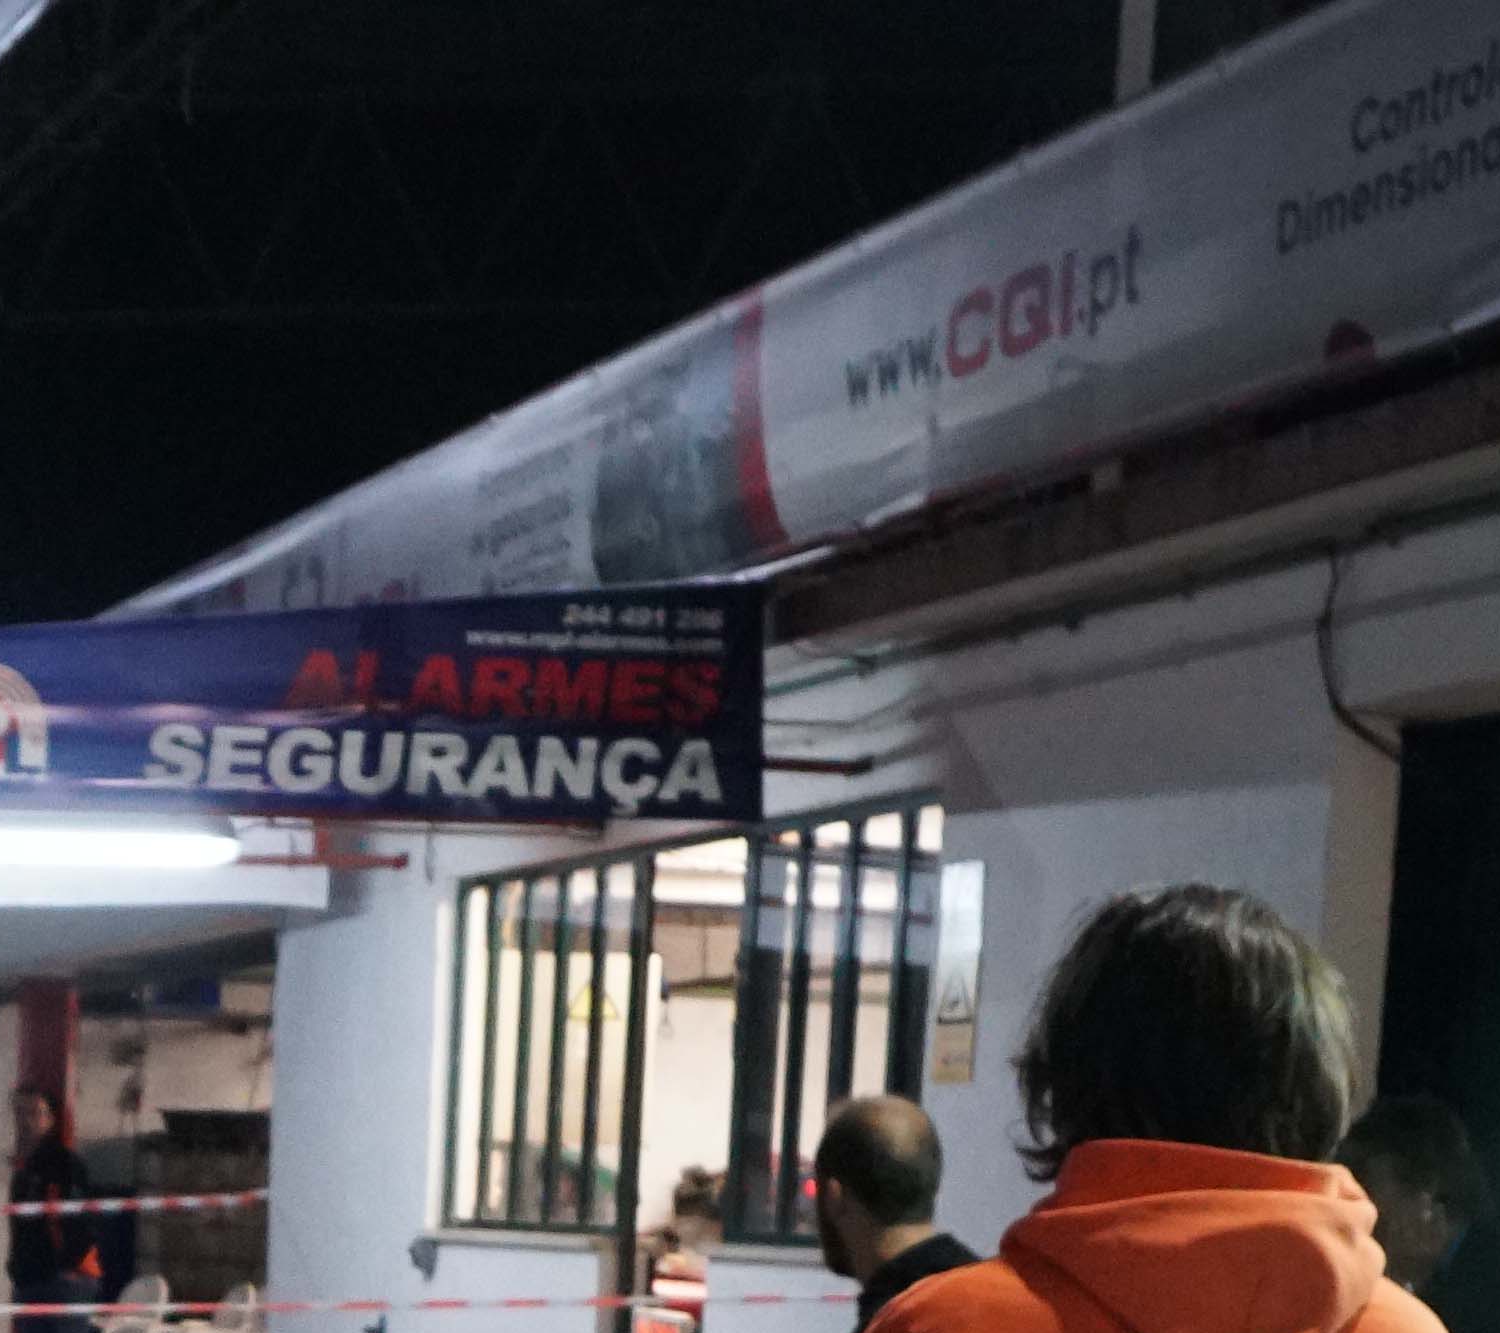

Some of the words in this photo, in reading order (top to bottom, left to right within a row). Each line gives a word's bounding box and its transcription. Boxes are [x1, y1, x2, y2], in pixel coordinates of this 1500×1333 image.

[845, 224, 1144, 407] www.CQI.pt
[284, 648, 722, 726] ALARMES
[144, 722, 723, 814] SEGURANÇA
